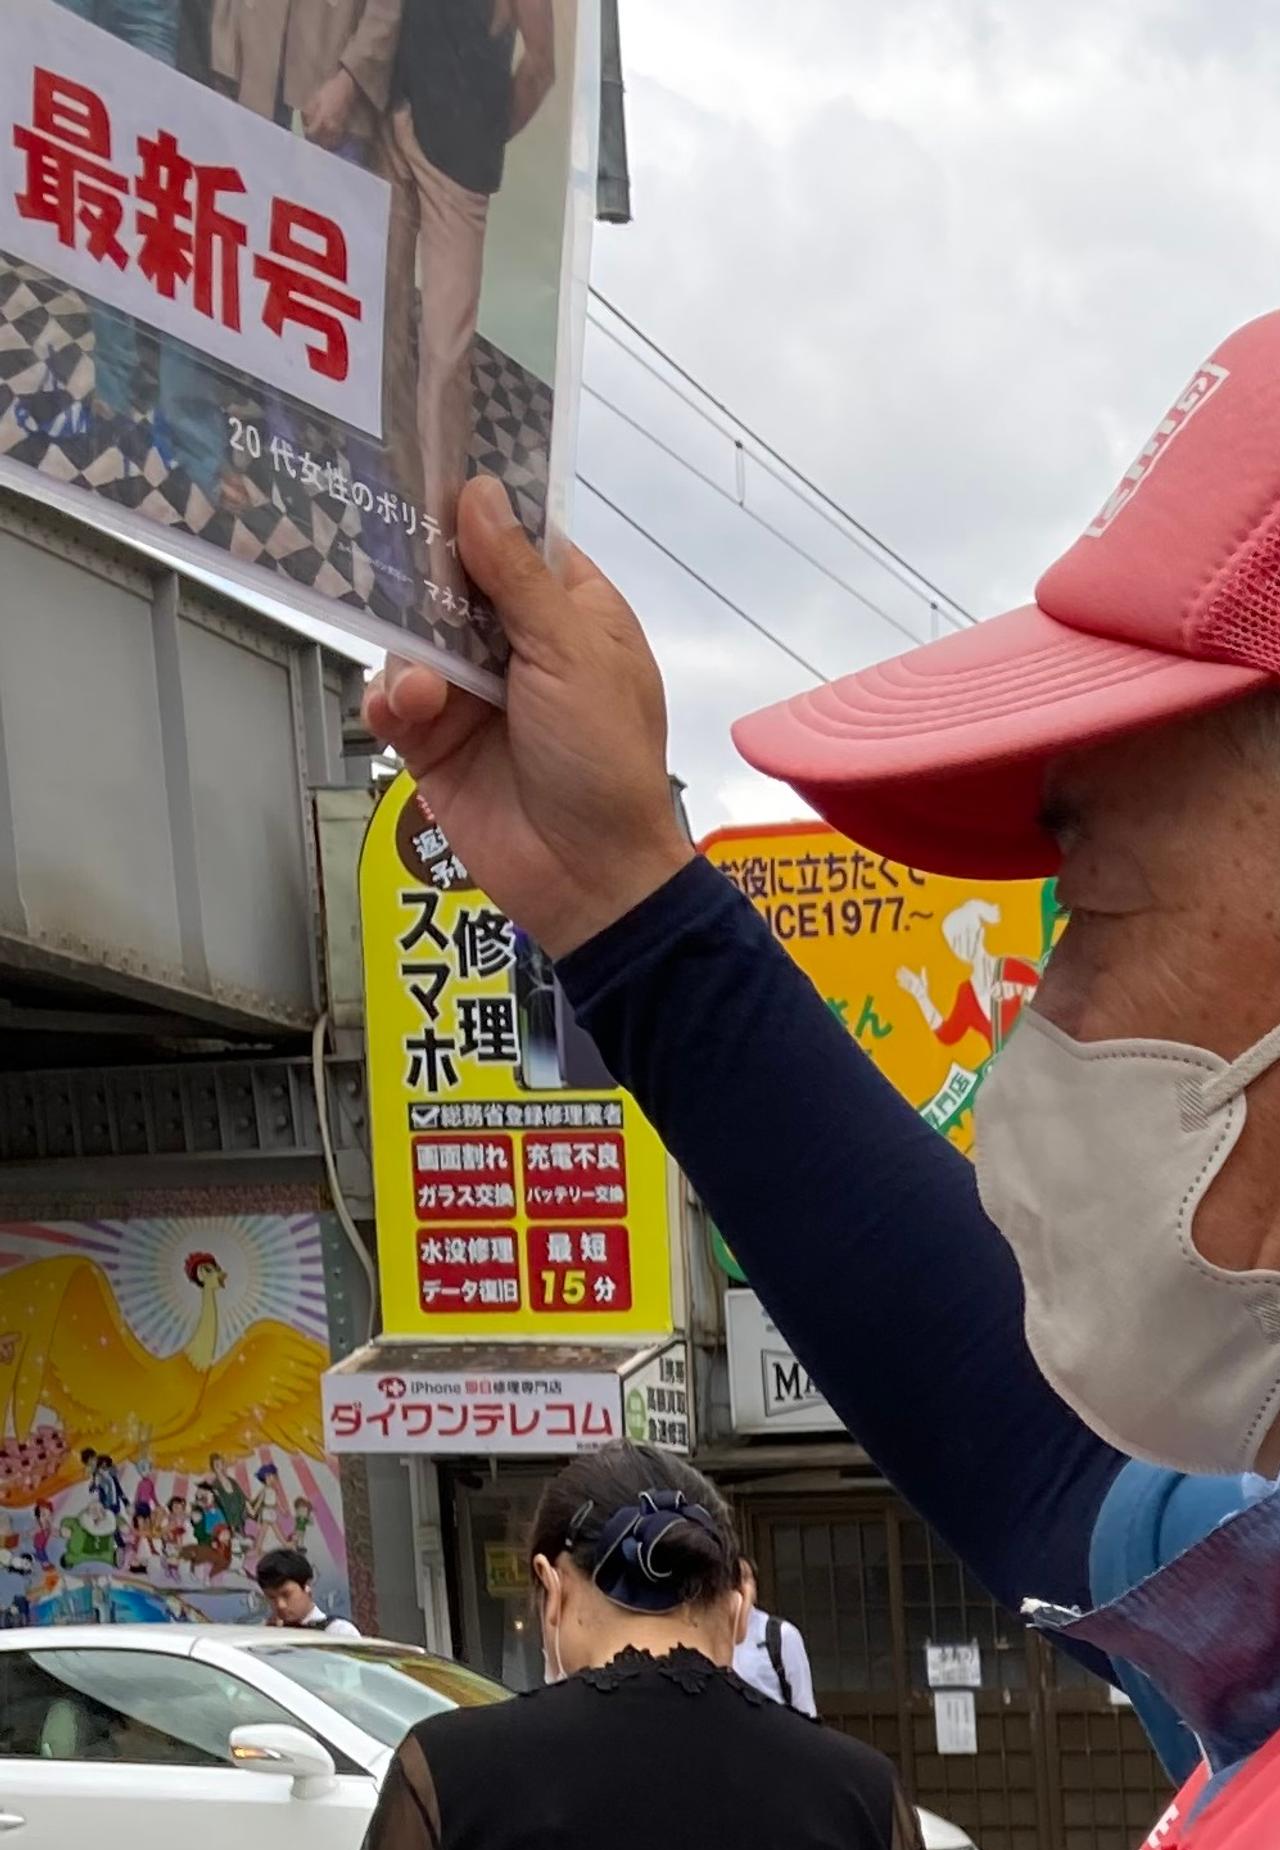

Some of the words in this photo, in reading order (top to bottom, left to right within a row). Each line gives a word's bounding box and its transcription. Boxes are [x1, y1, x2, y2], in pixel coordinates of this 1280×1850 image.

[13, 66, 361, 382] 最新号
[400, 892, 459, 1092] スマホ
[453, 908, 518, 1063] 修理
[416, 1143, 508, 1171] 画面割れ
[526, 1142, 619, 1170] 充電不良
[419, 1183, 515, 1208] ガラス交換
[527, 1184, 624, 1204] バッテリー交換
[421, 1236, 514, 1264] 水没修理
[548, 1232, 607, 1262] 最短
[423, 1278, 518, 1304] データ復旧
[331, 1402, 613, 1438] ダイワンテレコム
